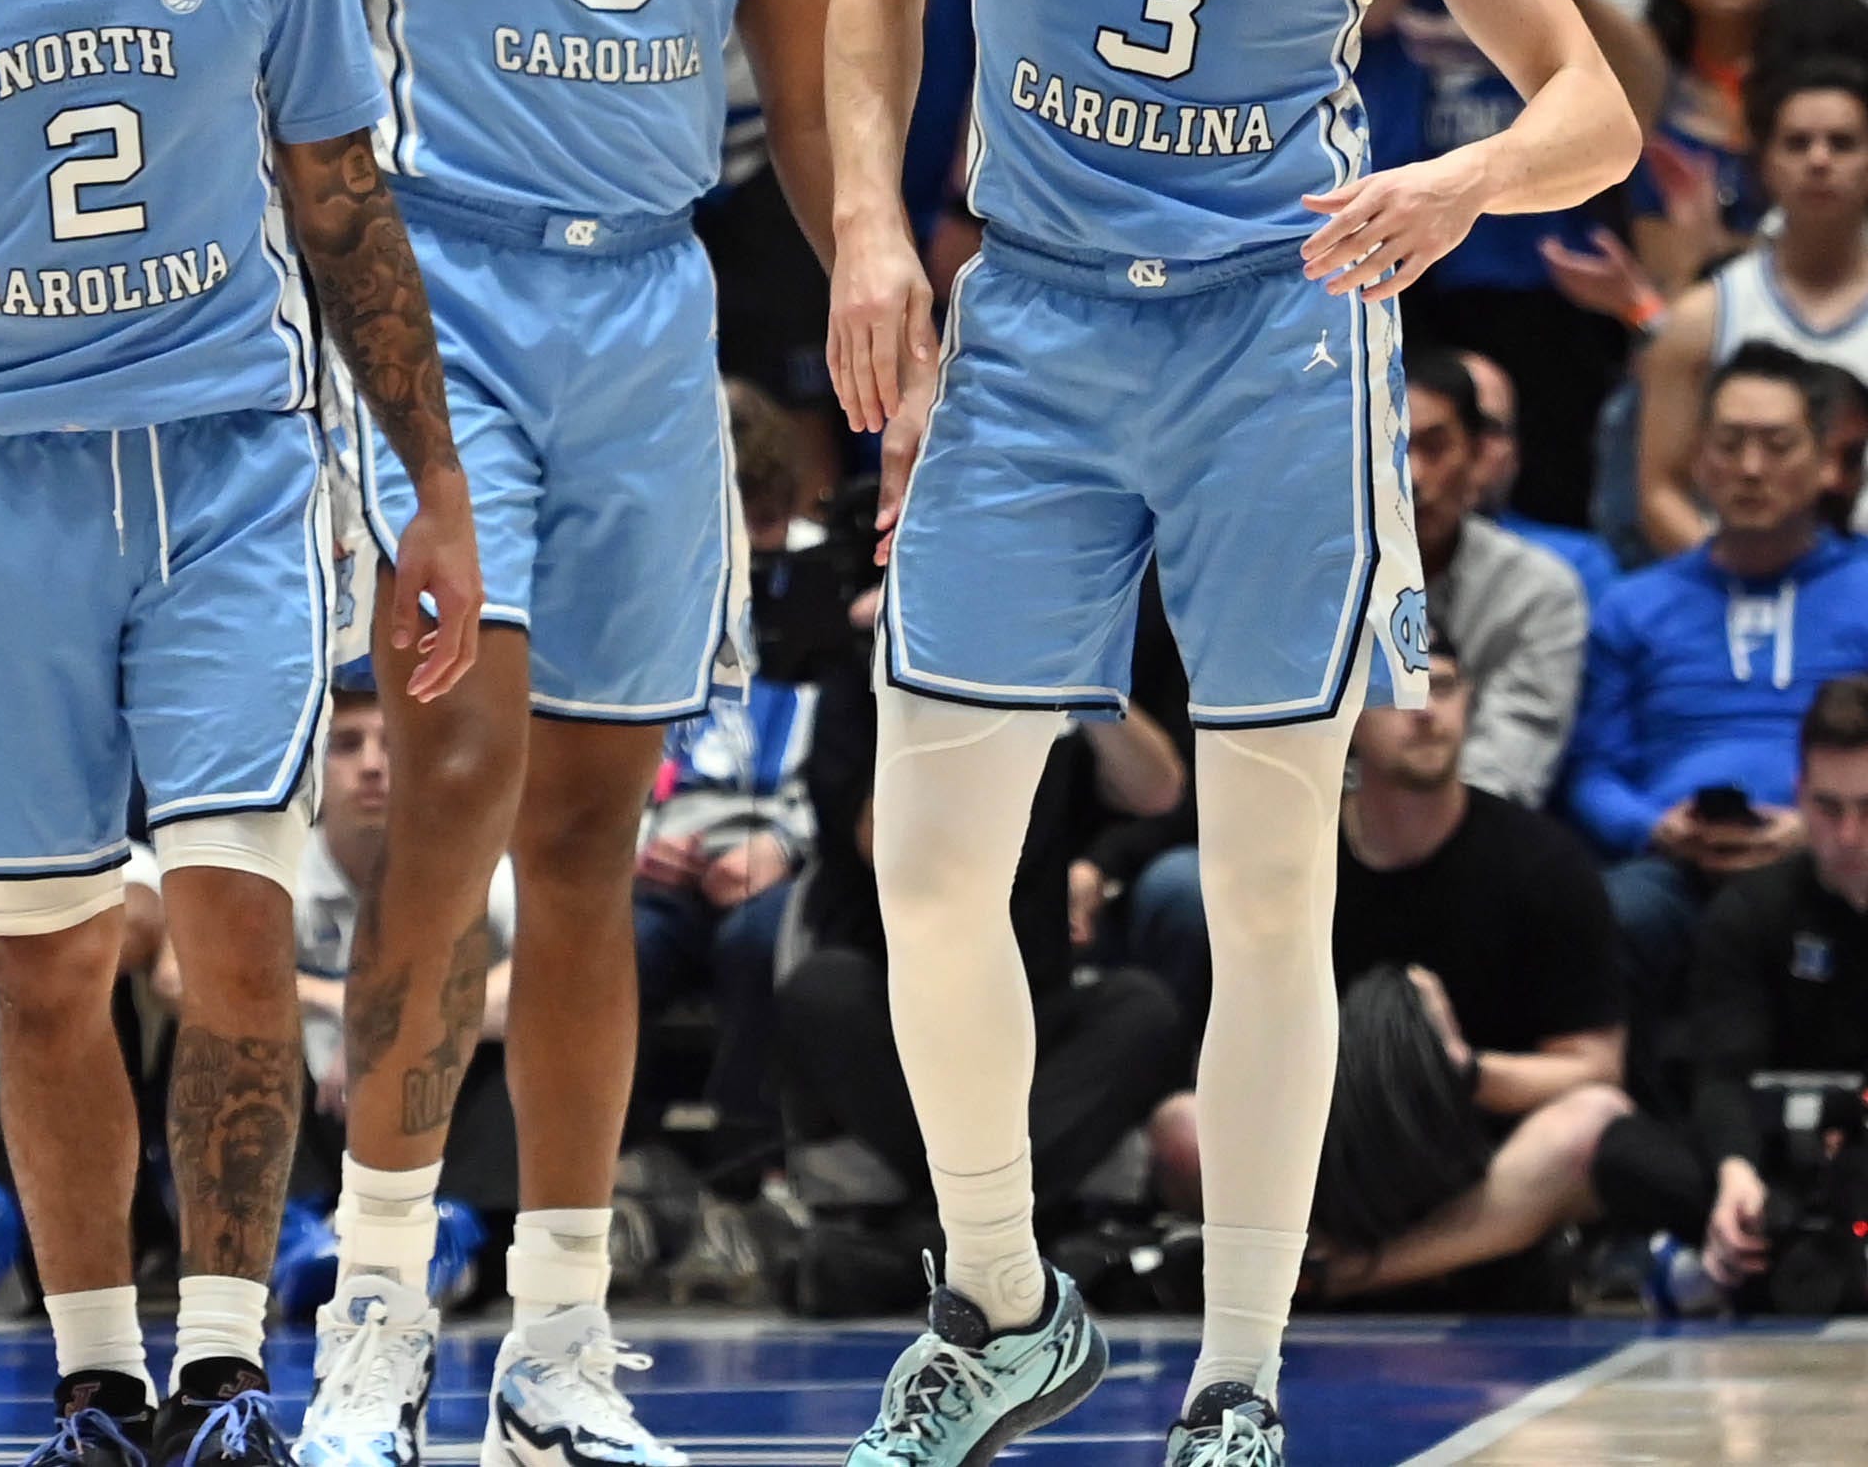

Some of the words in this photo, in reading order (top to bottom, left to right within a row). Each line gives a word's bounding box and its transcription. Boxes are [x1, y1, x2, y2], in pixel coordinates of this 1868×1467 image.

[493, 25, 701, 84] CAROLINA
[1011, 58, 1276, 157] CAROLINA
[43, 100, 147, 243] 2
